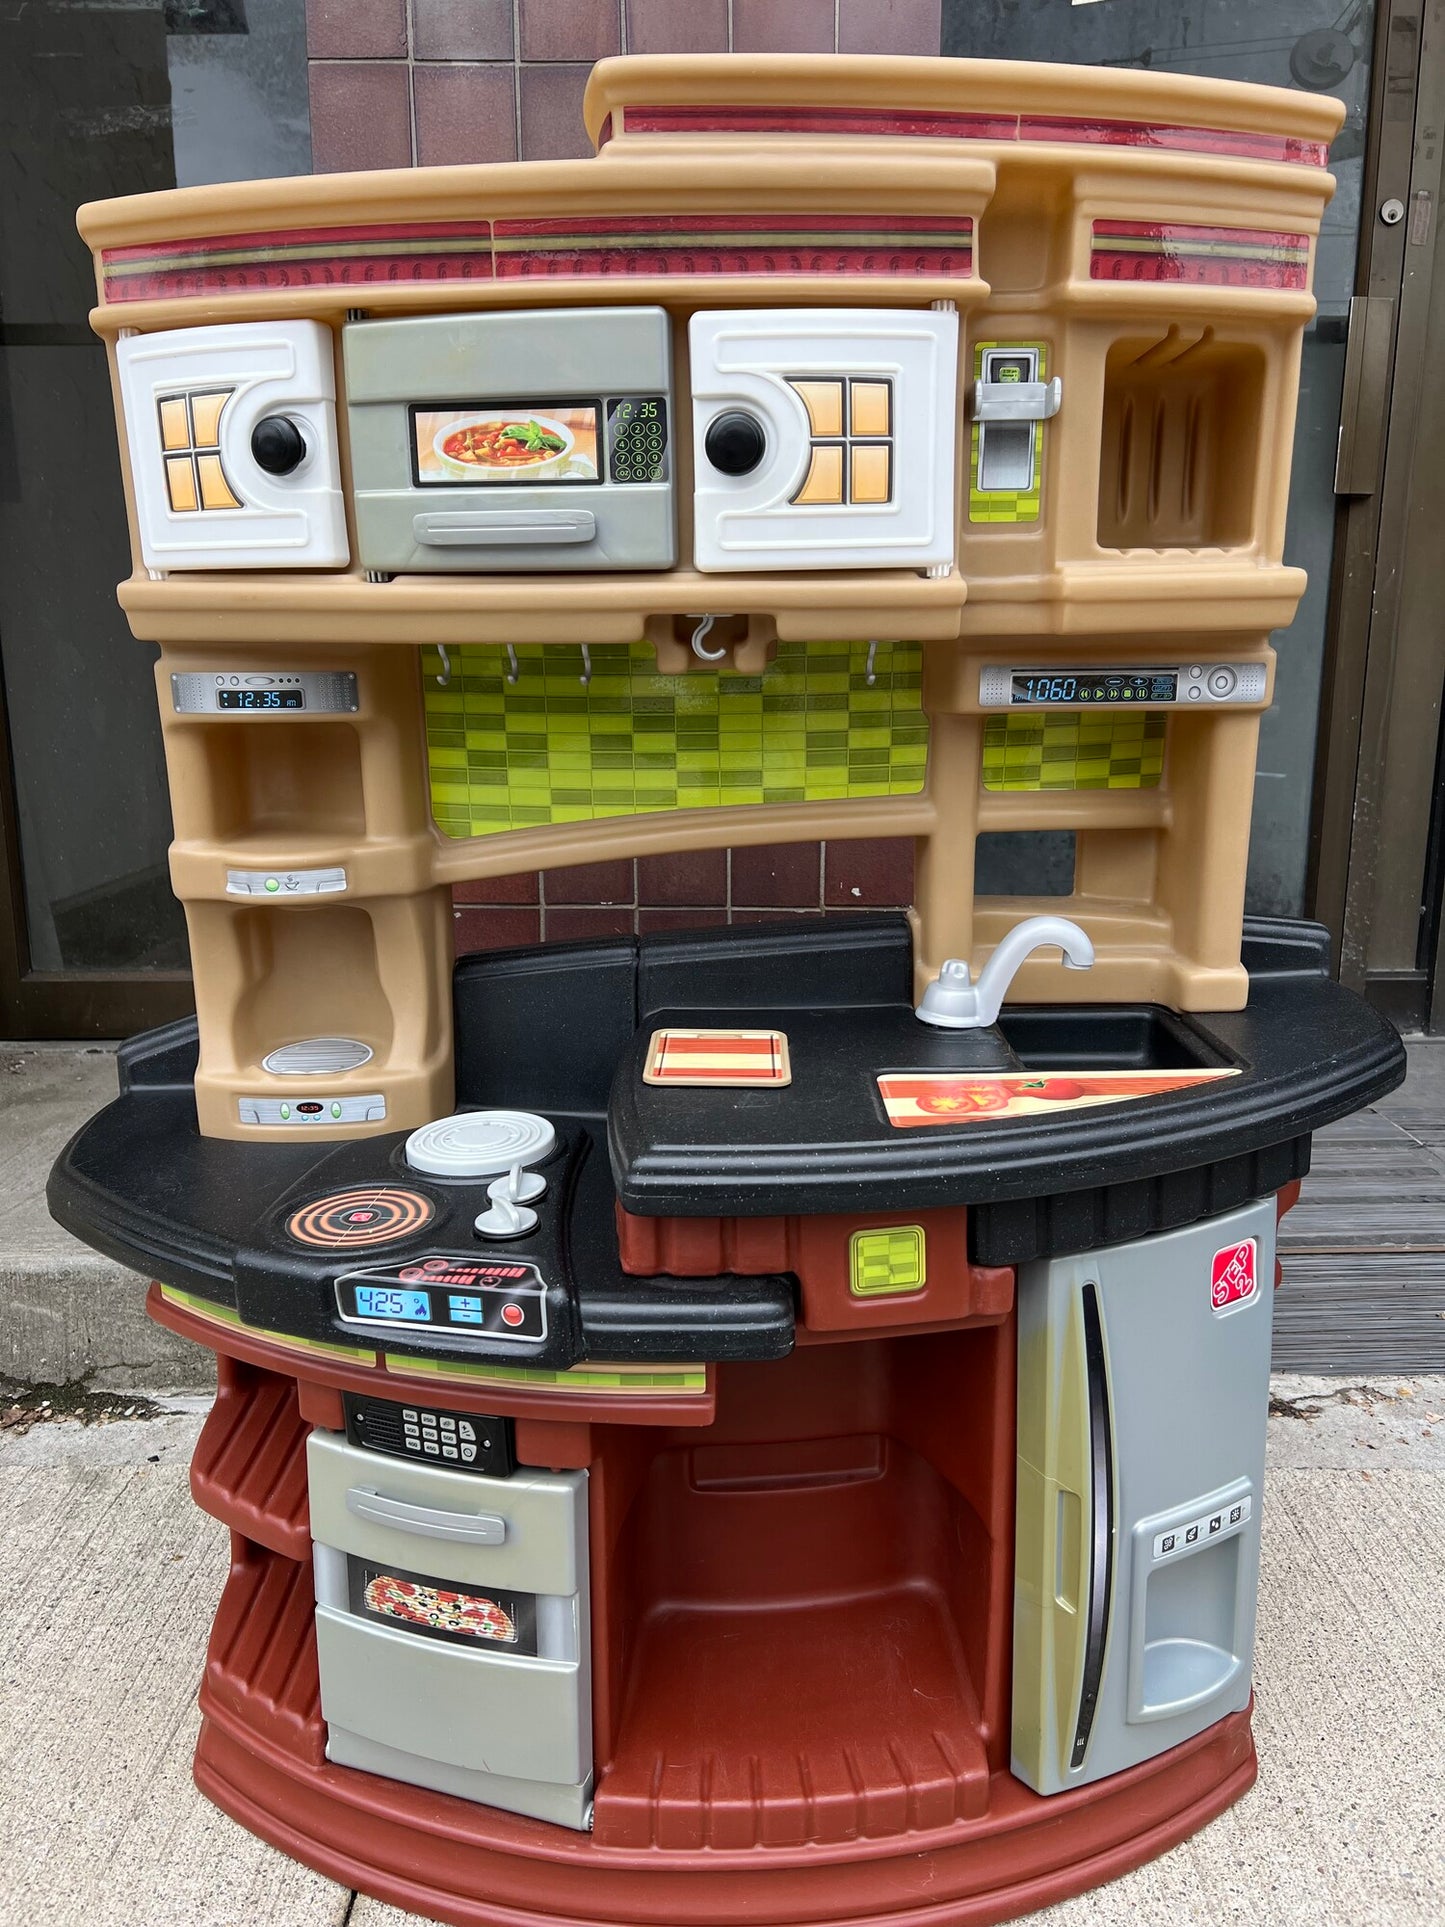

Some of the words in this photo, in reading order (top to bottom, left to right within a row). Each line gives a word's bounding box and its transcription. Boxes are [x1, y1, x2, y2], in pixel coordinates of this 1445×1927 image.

[615, 402, 658, 418] 12:35
[634, 425, 640, 434] 2
[651, 424, 657, 433] 3
[619, 440, 625, 448] 4
[635, 440, 641, 448] 5
[651, 439, 657, 447] 6
[620, 455, 625, 463] 7
[635, 454, 642, 462] 8
[652, 453, 658, 462] 9
[1026, 679, 1077, 700] 1060
[238, 692, 280, 707] 12:35
[1213, 1244, 1249, 1304] STEP
[1235, 1273, 1253, 1296] 2
[359, 1291, 403, 1314] 425
